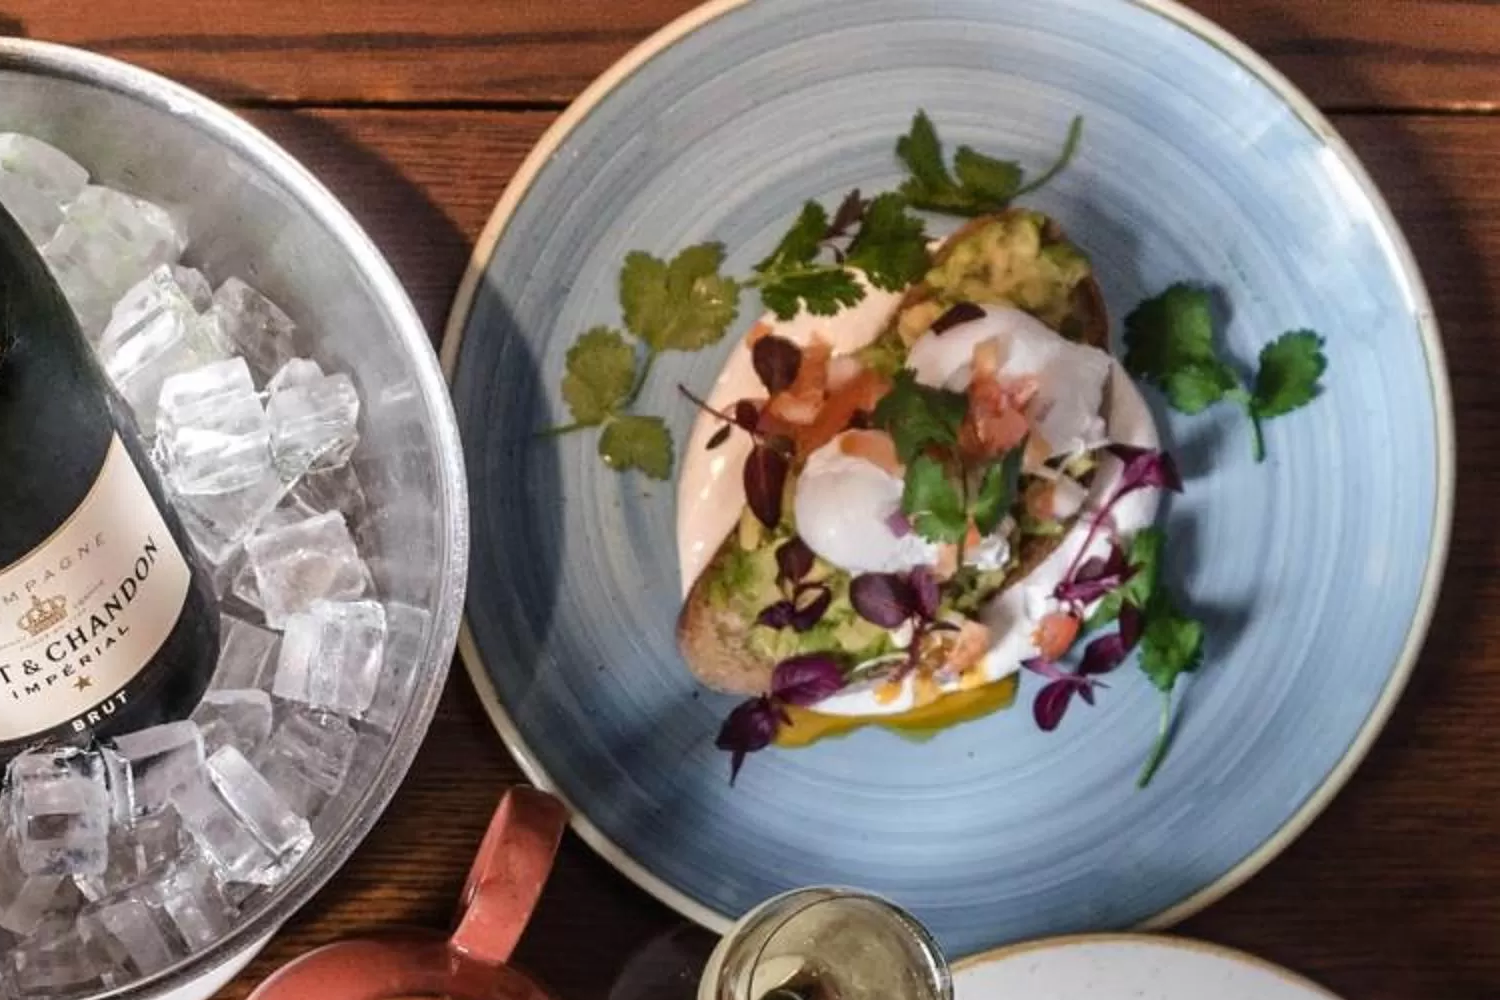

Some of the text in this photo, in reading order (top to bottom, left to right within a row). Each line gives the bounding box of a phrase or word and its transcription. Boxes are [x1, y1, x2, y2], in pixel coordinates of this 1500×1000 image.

[22, 658, 41, 676] &
[45, 534, 159, 662] CHANDON
[11, 625, 130, 700] IMPÉRIAL
[72, 689, 130, 732] BRUT
